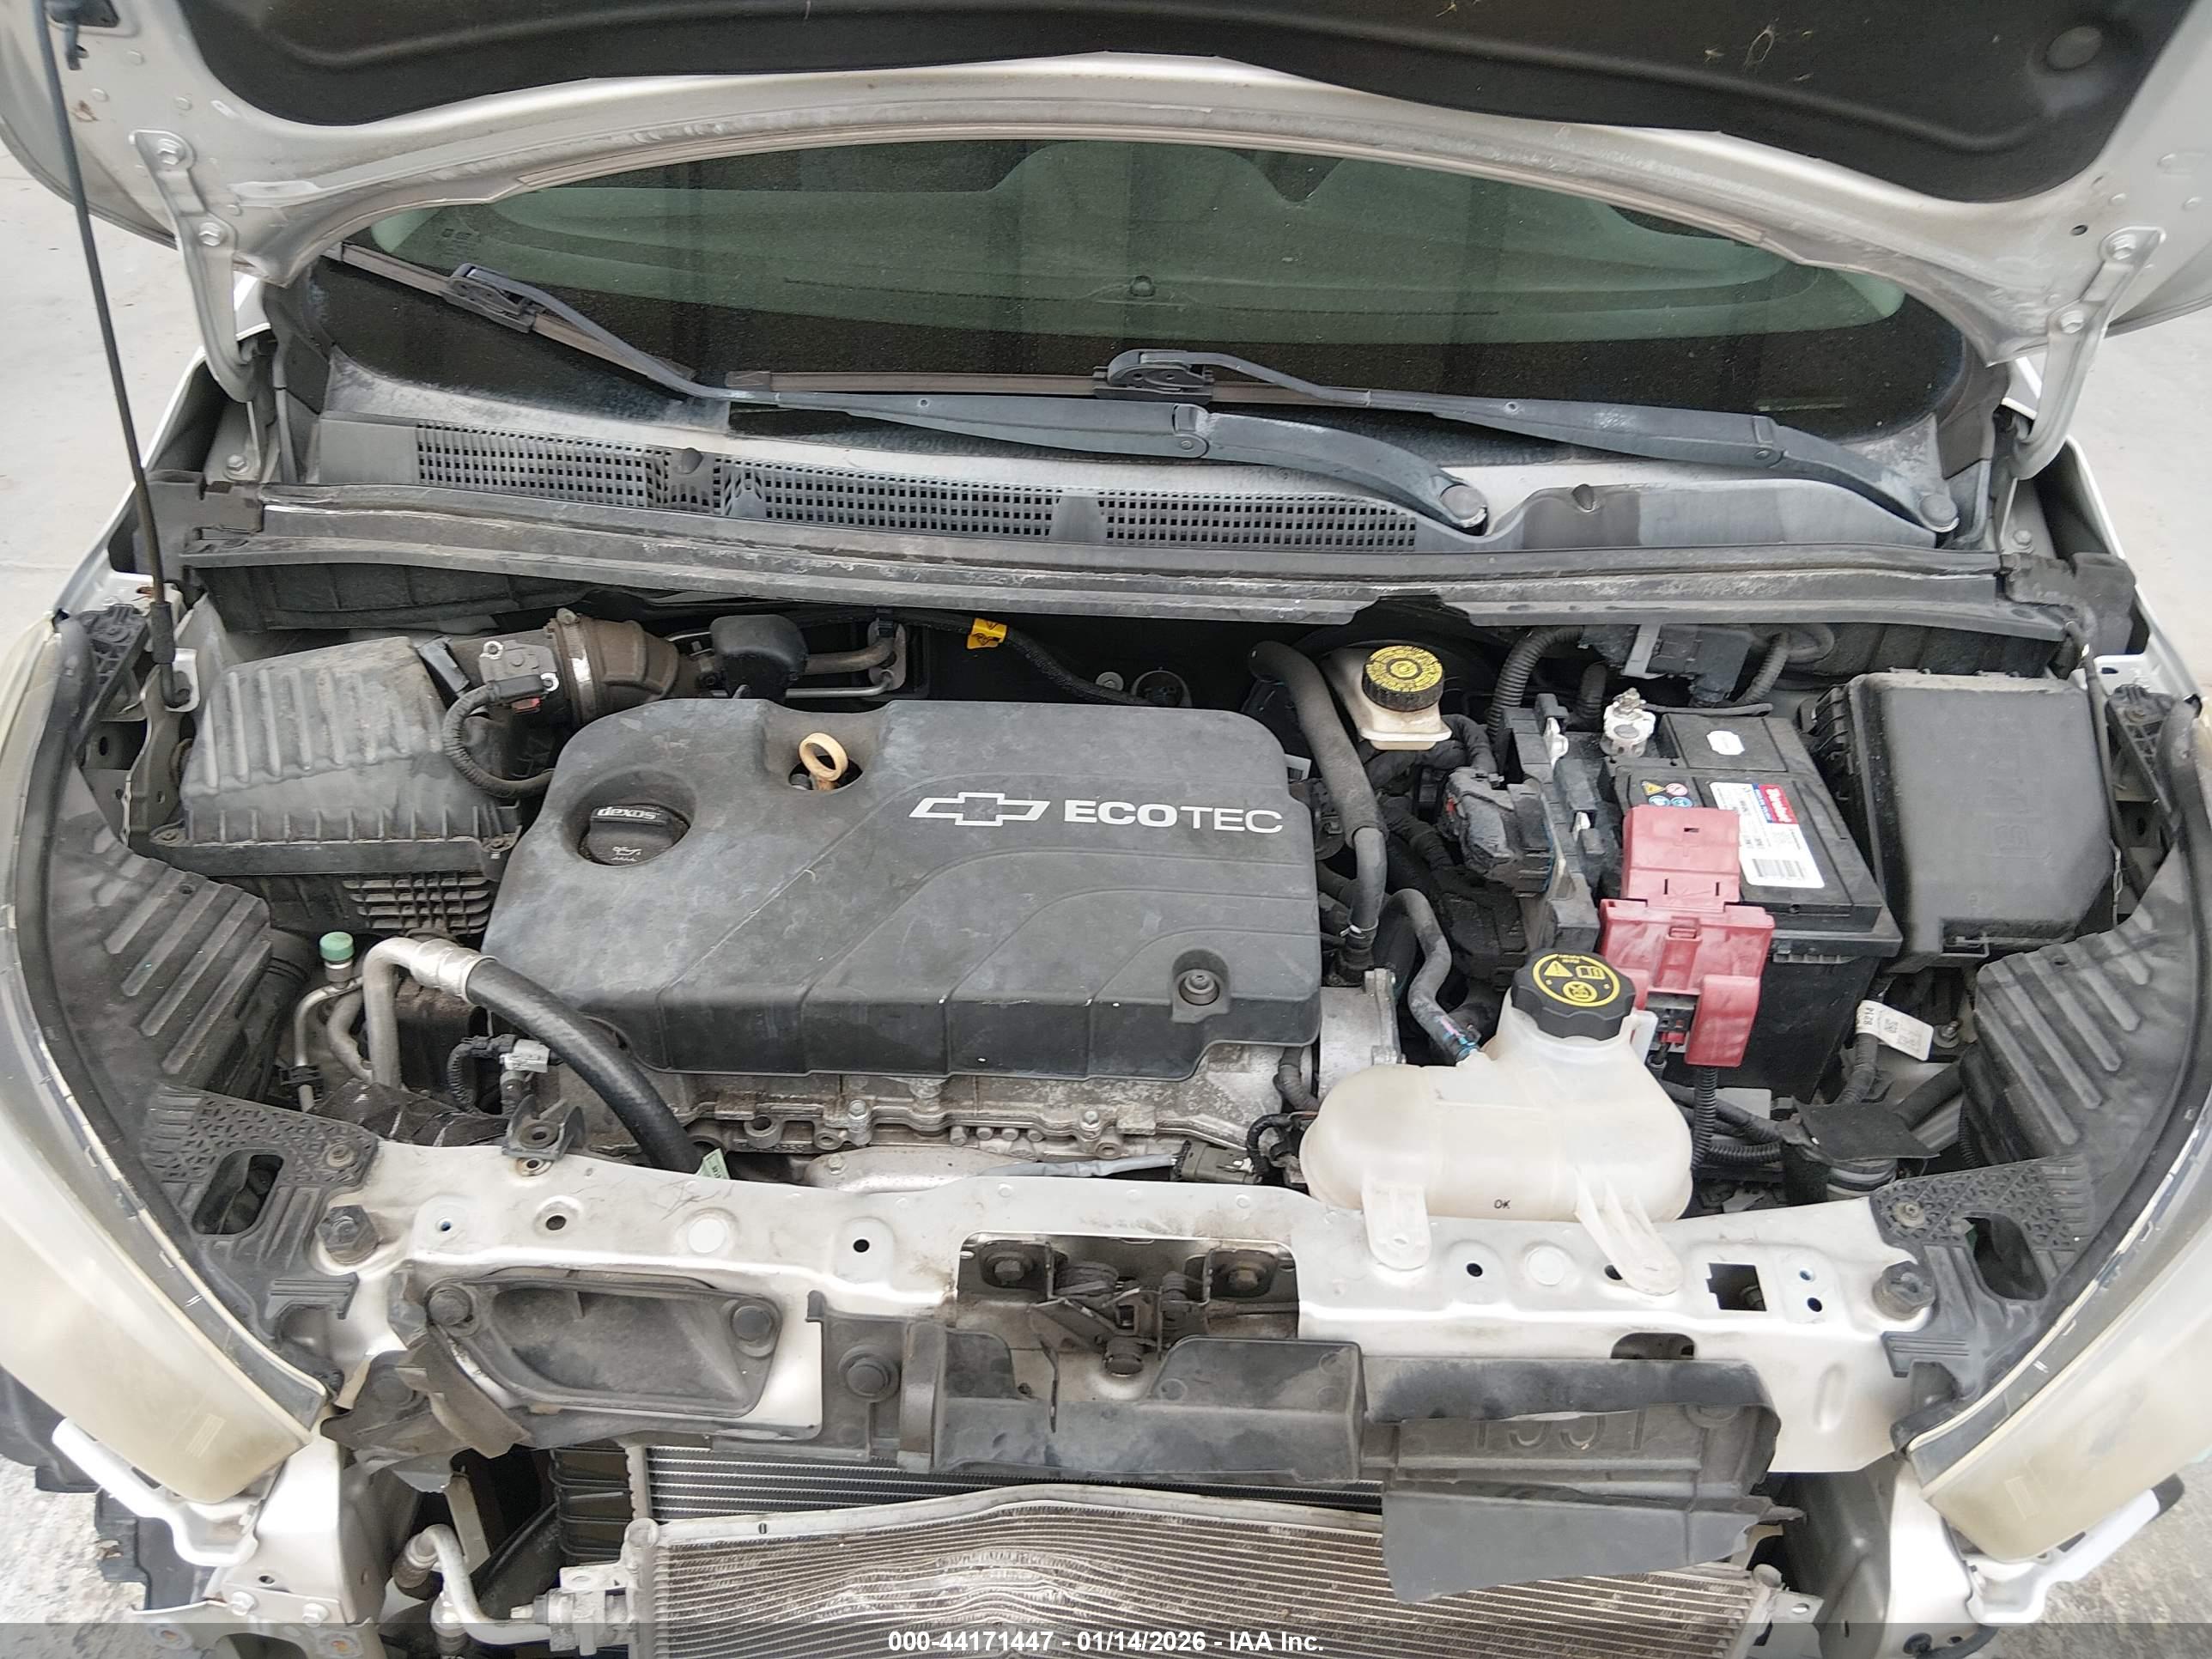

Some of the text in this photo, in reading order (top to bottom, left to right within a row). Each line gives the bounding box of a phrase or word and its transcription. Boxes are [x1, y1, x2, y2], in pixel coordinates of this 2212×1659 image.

[597, 806, 660, 819] dexos
[1064, 799, 1284, 834] ECOTEC
[1494, 1199, 1510, 1209] OK
